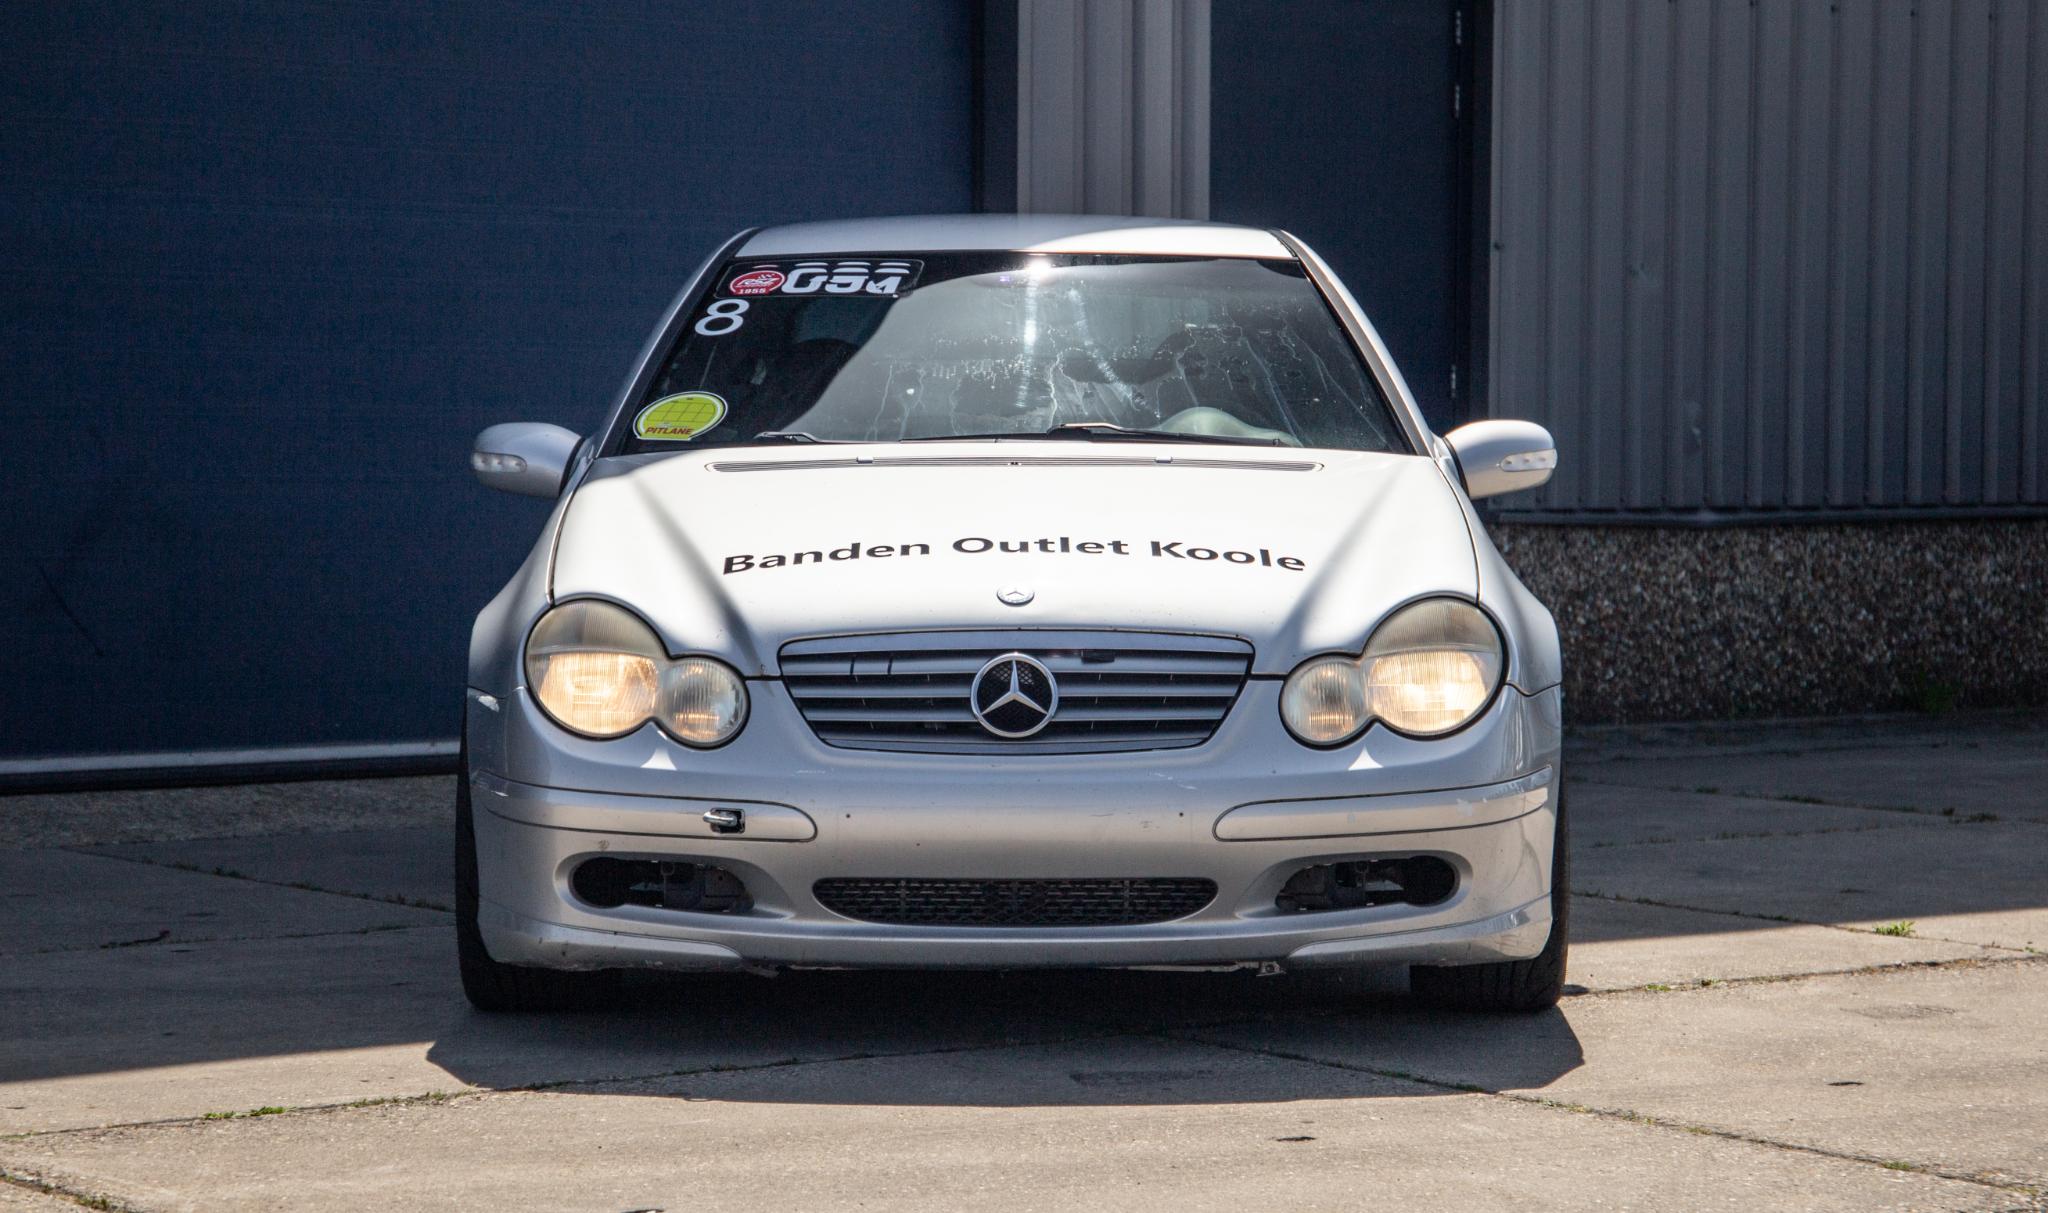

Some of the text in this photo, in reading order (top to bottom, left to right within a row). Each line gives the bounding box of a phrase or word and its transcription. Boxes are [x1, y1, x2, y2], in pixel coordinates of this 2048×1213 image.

[695, 299, 749, 335] 8
[644, 426, 693, 435] PITLANE
[723, 537, 1306, 575] Banden Outlet Koole
